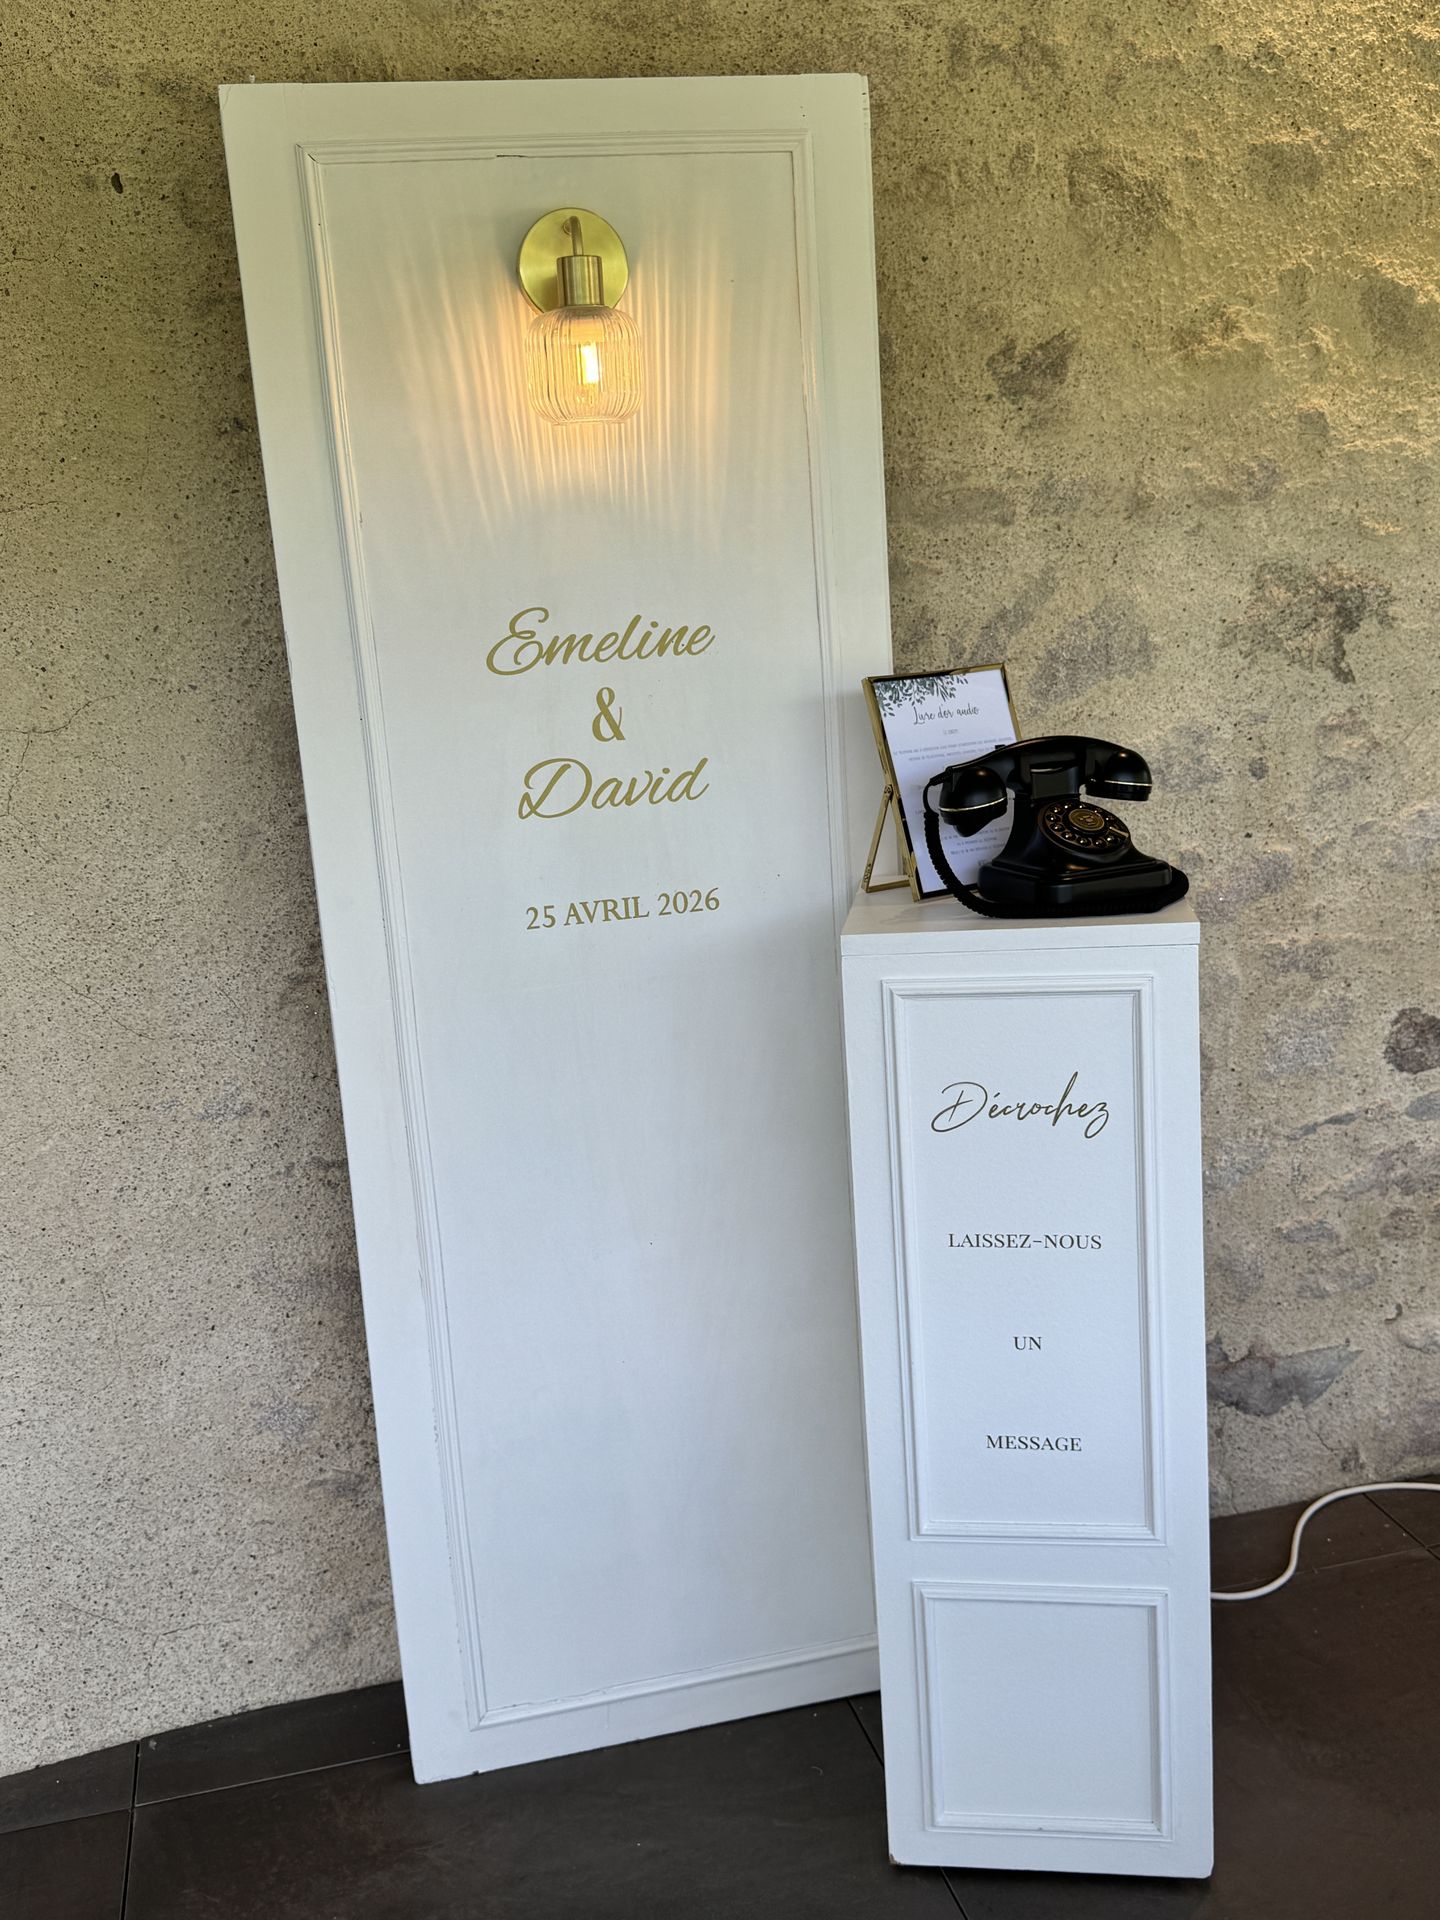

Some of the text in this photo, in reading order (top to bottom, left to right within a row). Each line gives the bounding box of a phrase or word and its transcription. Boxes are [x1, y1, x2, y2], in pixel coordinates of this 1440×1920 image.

[486, 606, 716, 676] Emeline
[591, 686, 627, 743] &
[517, 757, 710, 821] David
[526, 887, 720, 931] 25 AVRIL 2026
[930, 1070, 1110, 1140] Décrochez
[948, 1233, 1102, 1250] LAISSEZ-NOUS
[1013, 1335, 1043, 1351] UN
[986, 1434, 1083, 1453] MESSAGE
